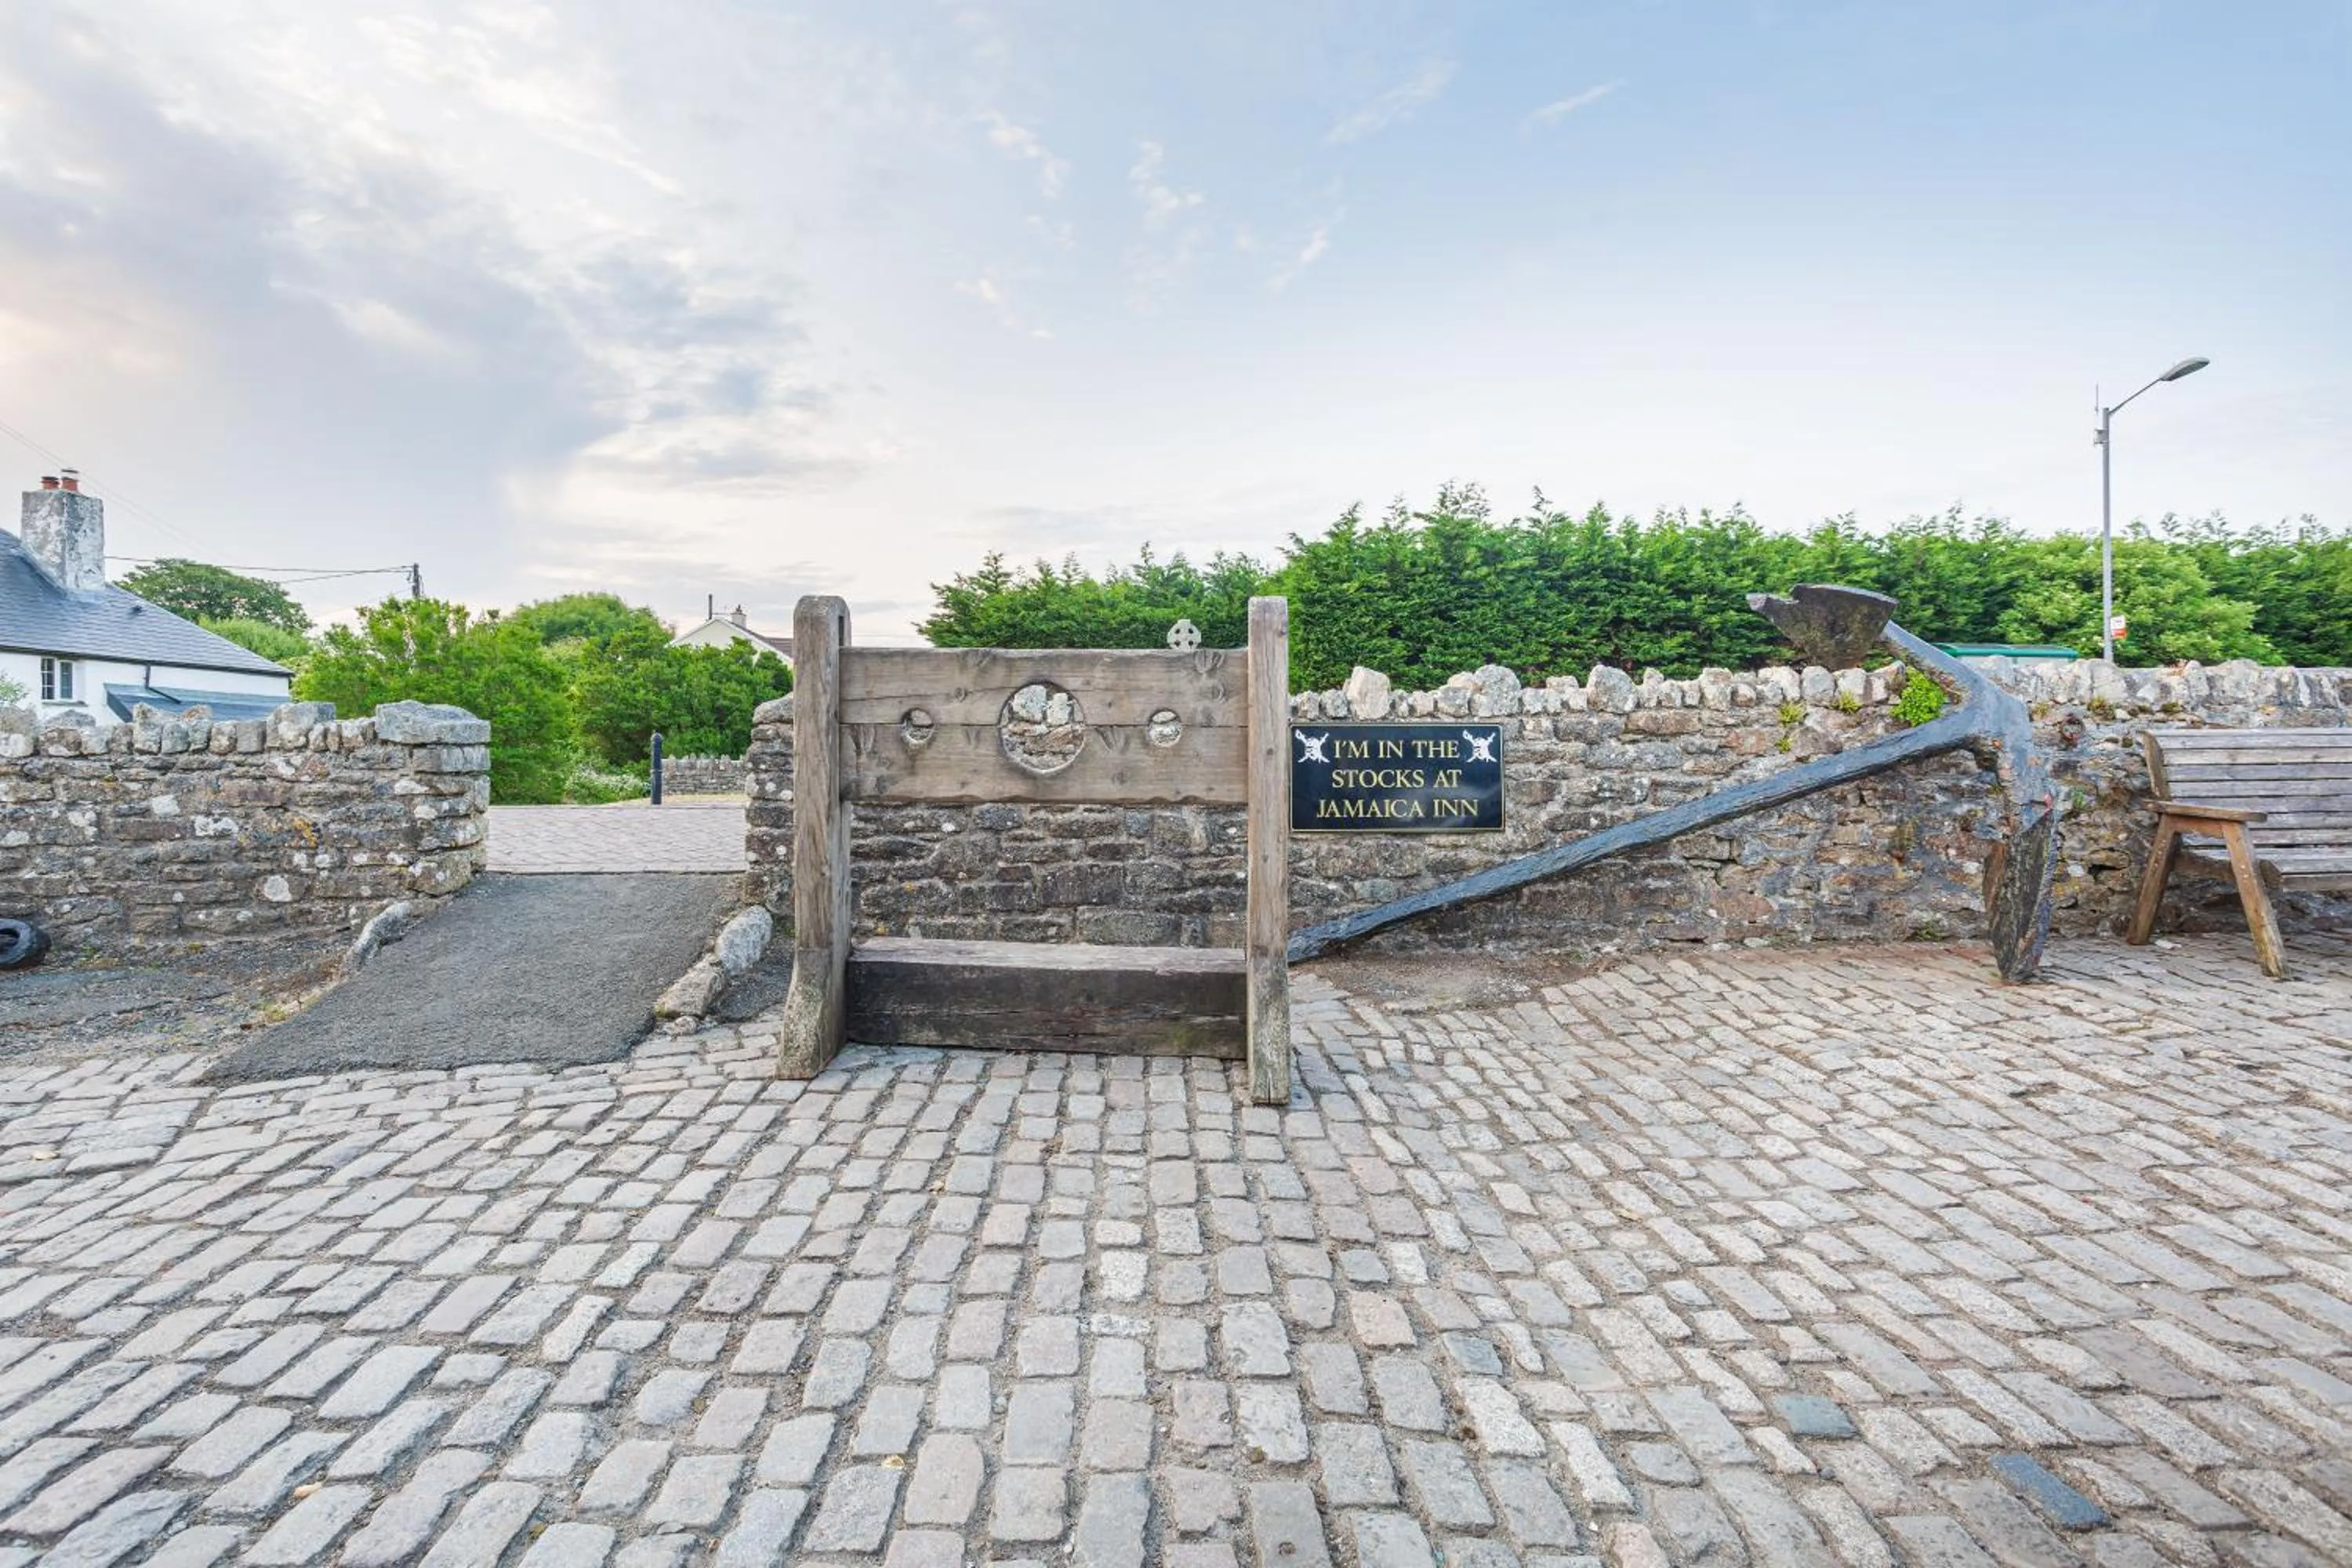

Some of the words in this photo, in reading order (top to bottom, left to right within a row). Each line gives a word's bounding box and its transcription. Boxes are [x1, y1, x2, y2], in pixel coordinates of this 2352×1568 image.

[1333, 739, 1368, 759] I'M
[1377, 739, 1403, 759] IN
[1411, 739, 1461, 759] THE
[1332, 769, 1425, 789] STOCKS
[1433, 769, 1462, 789] AT
[1316, 799, 1425, 818] JAMAICA
[1432, 799, 1479, 817] INN
